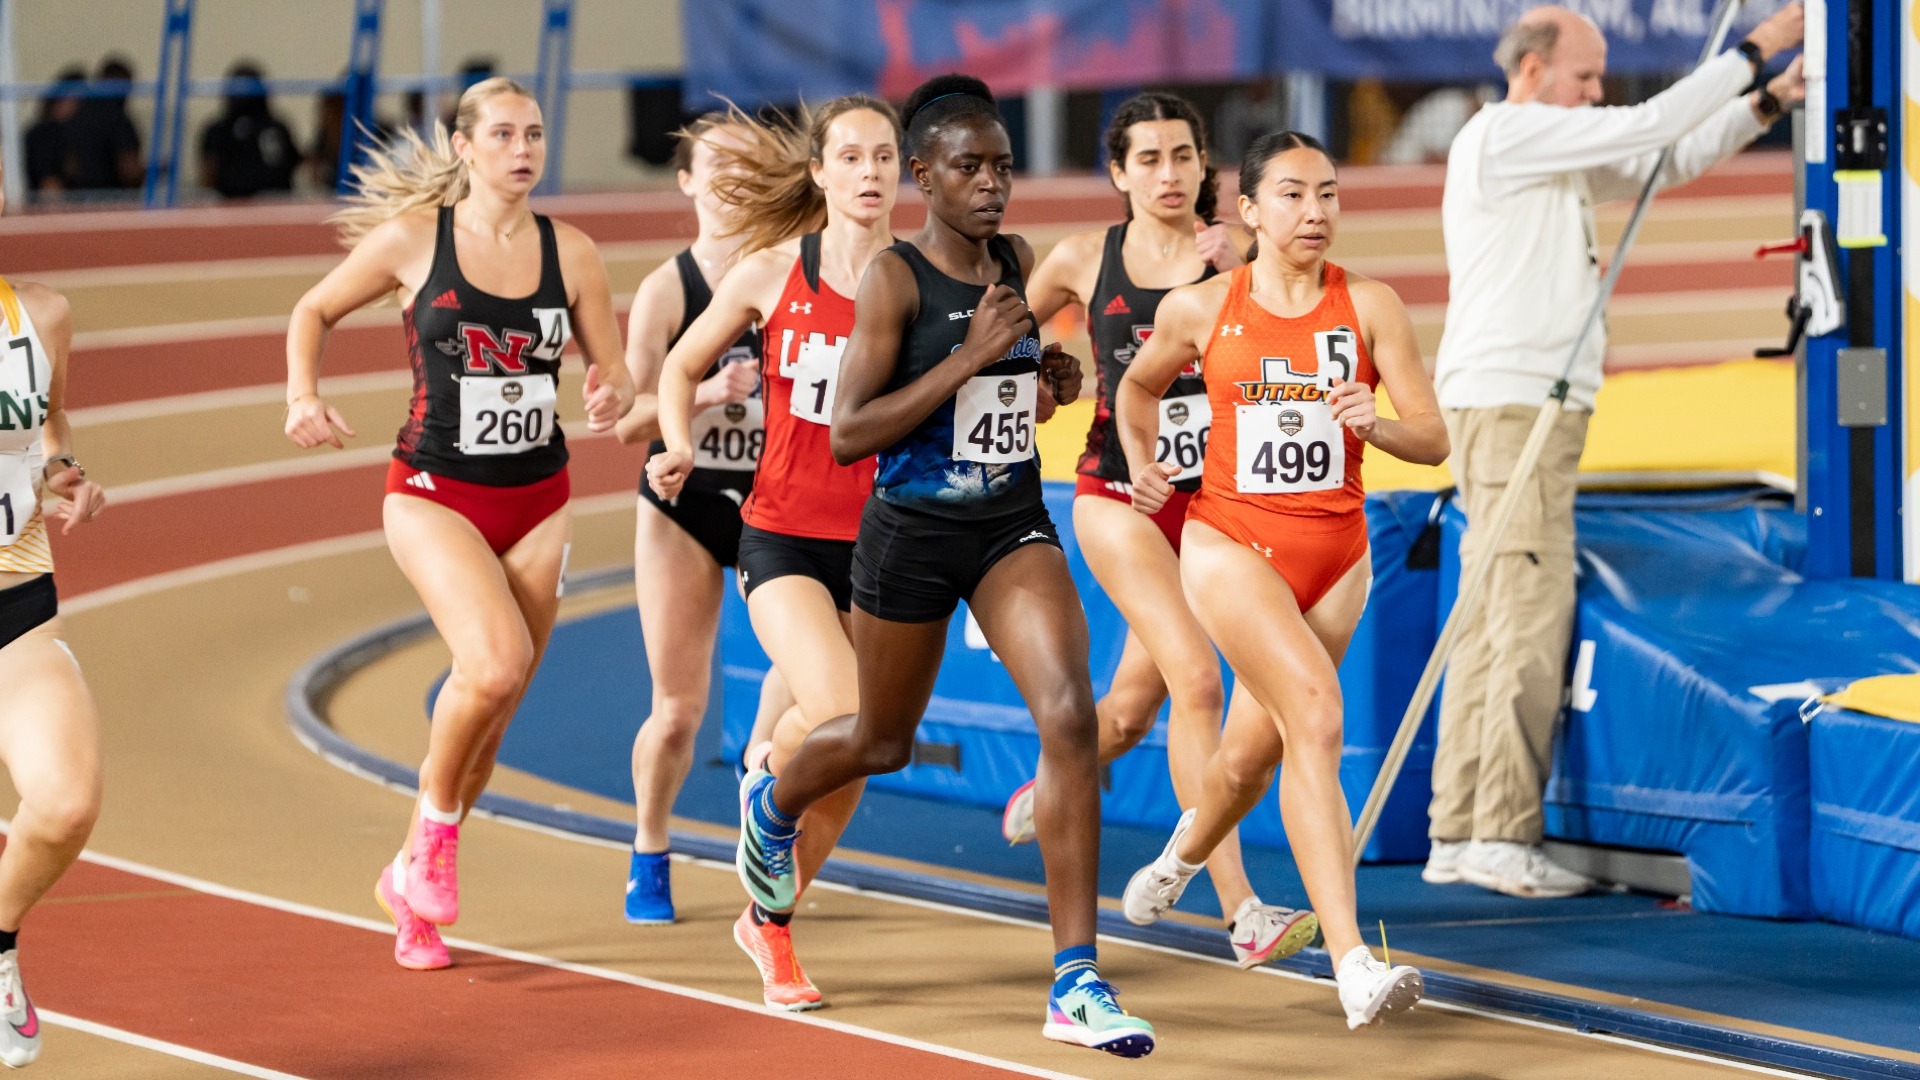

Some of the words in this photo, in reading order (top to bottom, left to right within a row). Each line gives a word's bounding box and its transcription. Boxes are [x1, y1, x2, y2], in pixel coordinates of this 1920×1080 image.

[544, 312, 563, 357] 4
[8, 336, 36, 393] 7
[1327, 335, 1351, 388] 5
[811, 379, 828, 415] 1
[475, 407, 543, 445] 260
[700, 427, 765, 462] 408
[968, 410, 1030, 455] 455
[1251, 441, 1331, 484] 499
